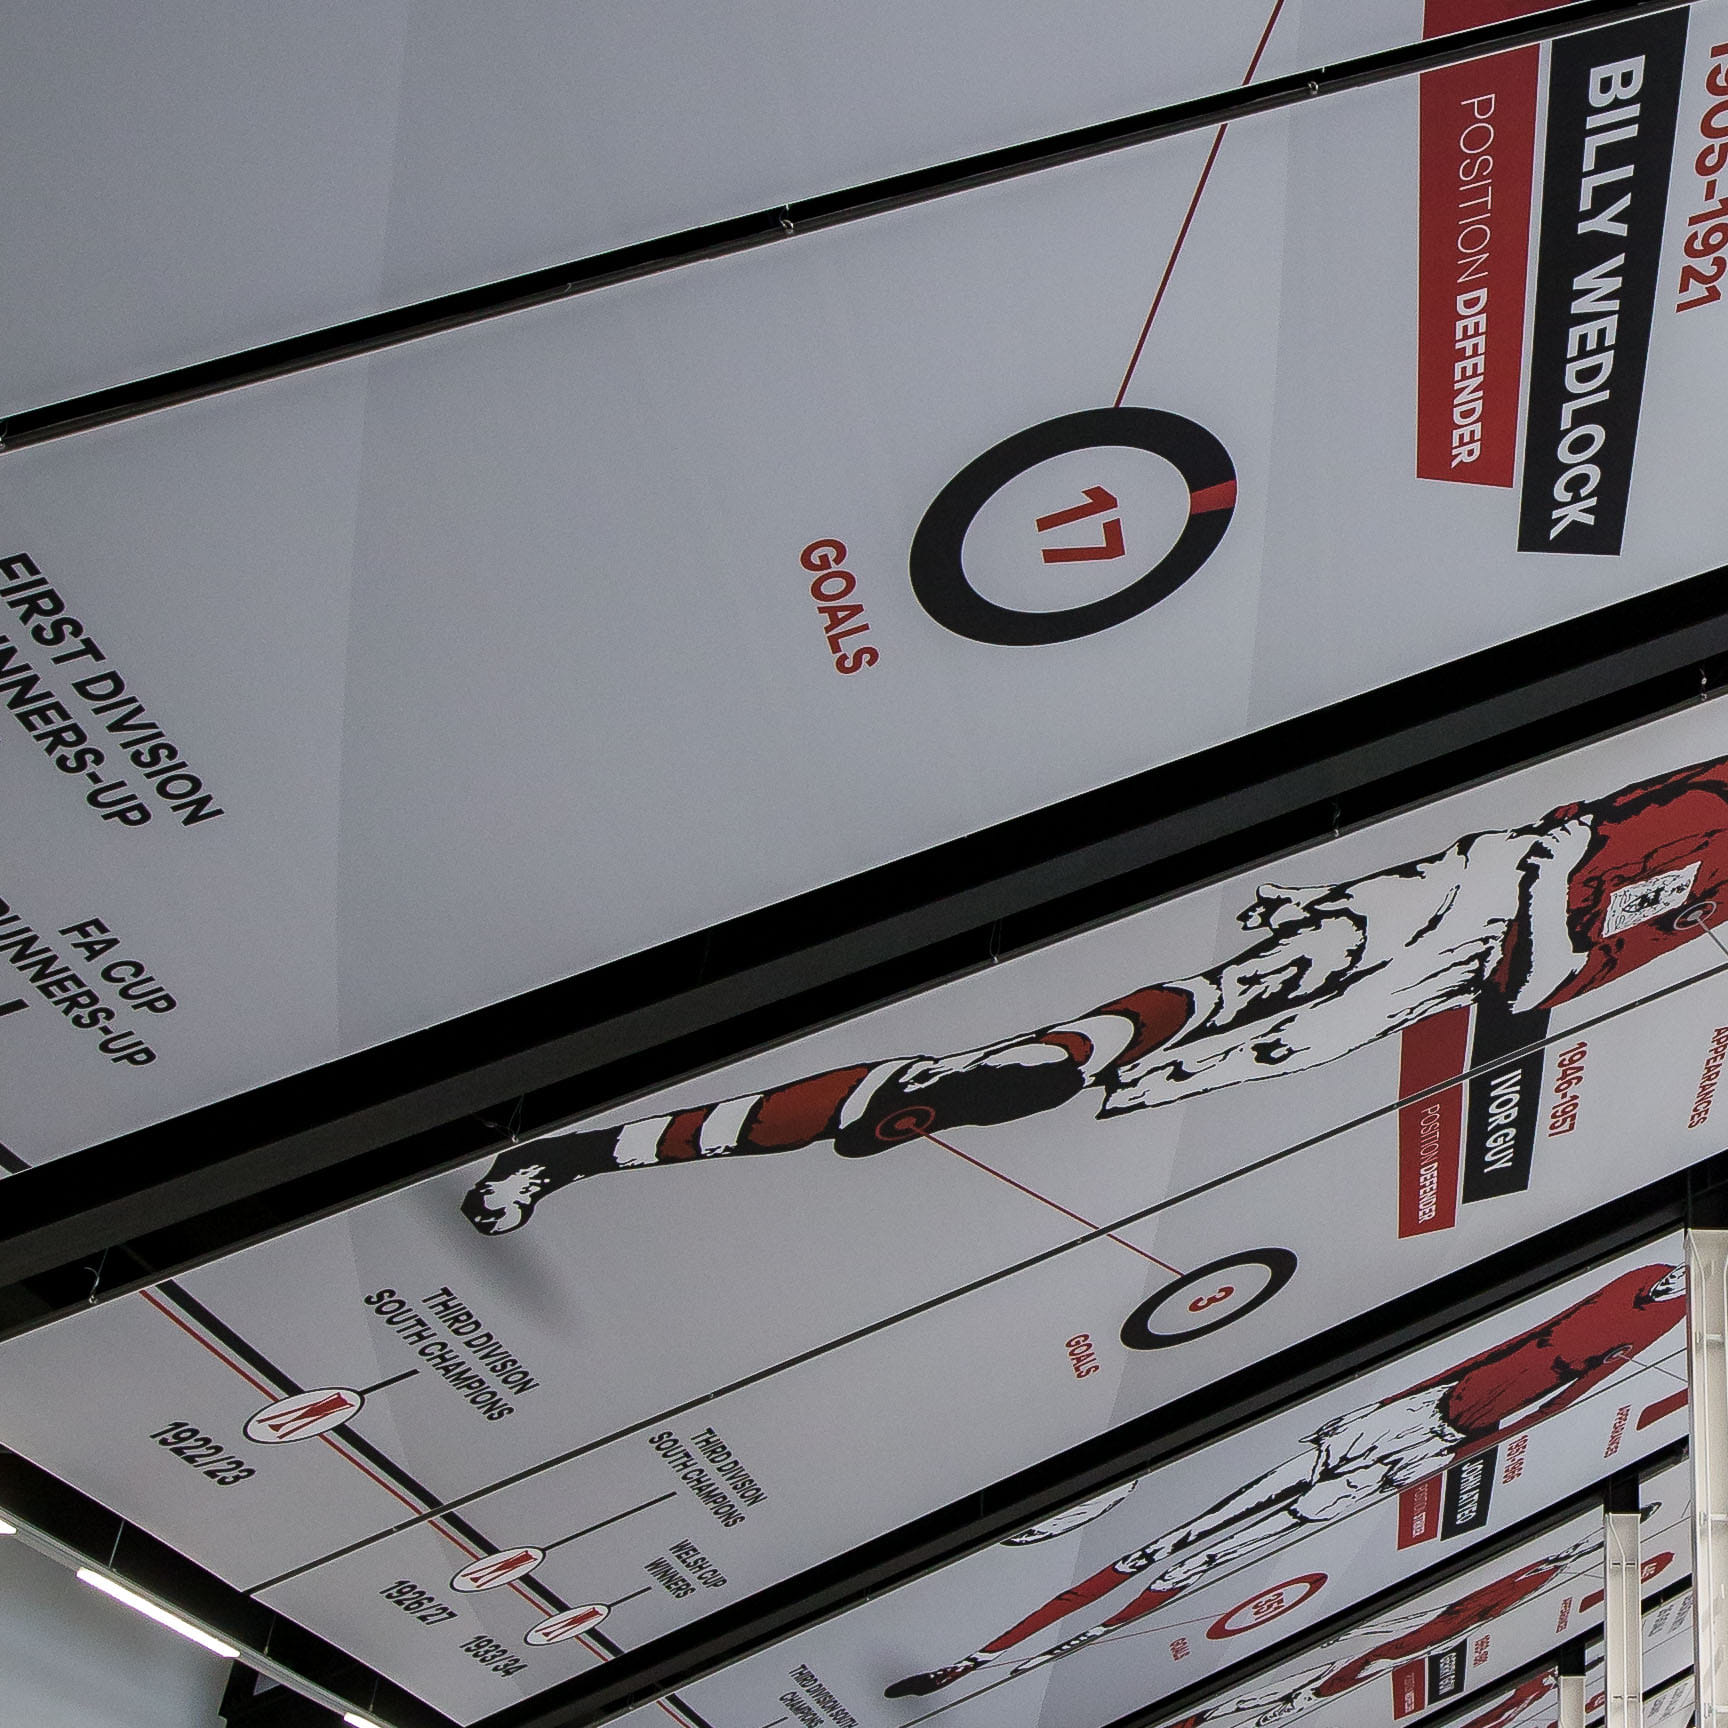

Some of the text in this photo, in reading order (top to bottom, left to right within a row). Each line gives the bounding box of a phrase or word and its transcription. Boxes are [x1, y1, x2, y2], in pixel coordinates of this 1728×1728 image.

[1450, 92, 1496, 468] POSITION DEFENDER
[1550, 53, 1646, 540] BILLY WEDLOCK
[1036, 485, 1126, 564] 17
[800, 538, 879, 675] GOALS
[0, 553, 225, 828] FIRST DIVISION
[0, 634, 152, 828] NNERS-UP
[58, 917, 177, 1013] FA CUP
[1484, 1069, 1522, 1173] IVOR GUY
[1548, 1041, 1587, 1137] 1946-1957
[1419, 1104, 1440, 1224] POSITION DEFENDER
[422, 1287, 540, 1395] THIRD DIVISION
[1187, 1286, 1235, 1312] 3
[364, 1288, 514, 1421] SOUTH CHAMPIONS
[1065, 1333, 1100, 1379] GOALS
[149, 1420, 257, 1486] 1922/23
[648, 1431, 746, 1528] SOUTH CHAMPIONS
[690, 1427, 768, 1507] THIRD DIVISION
[1456, 1458, 1484, 1525] JOHN ATYEO
[378, 1579, 459, 1627] 1926/27
[644, 1556, 697, 1599] WINNERS
[669, 1539, 728, 1590] WELSH CUP
